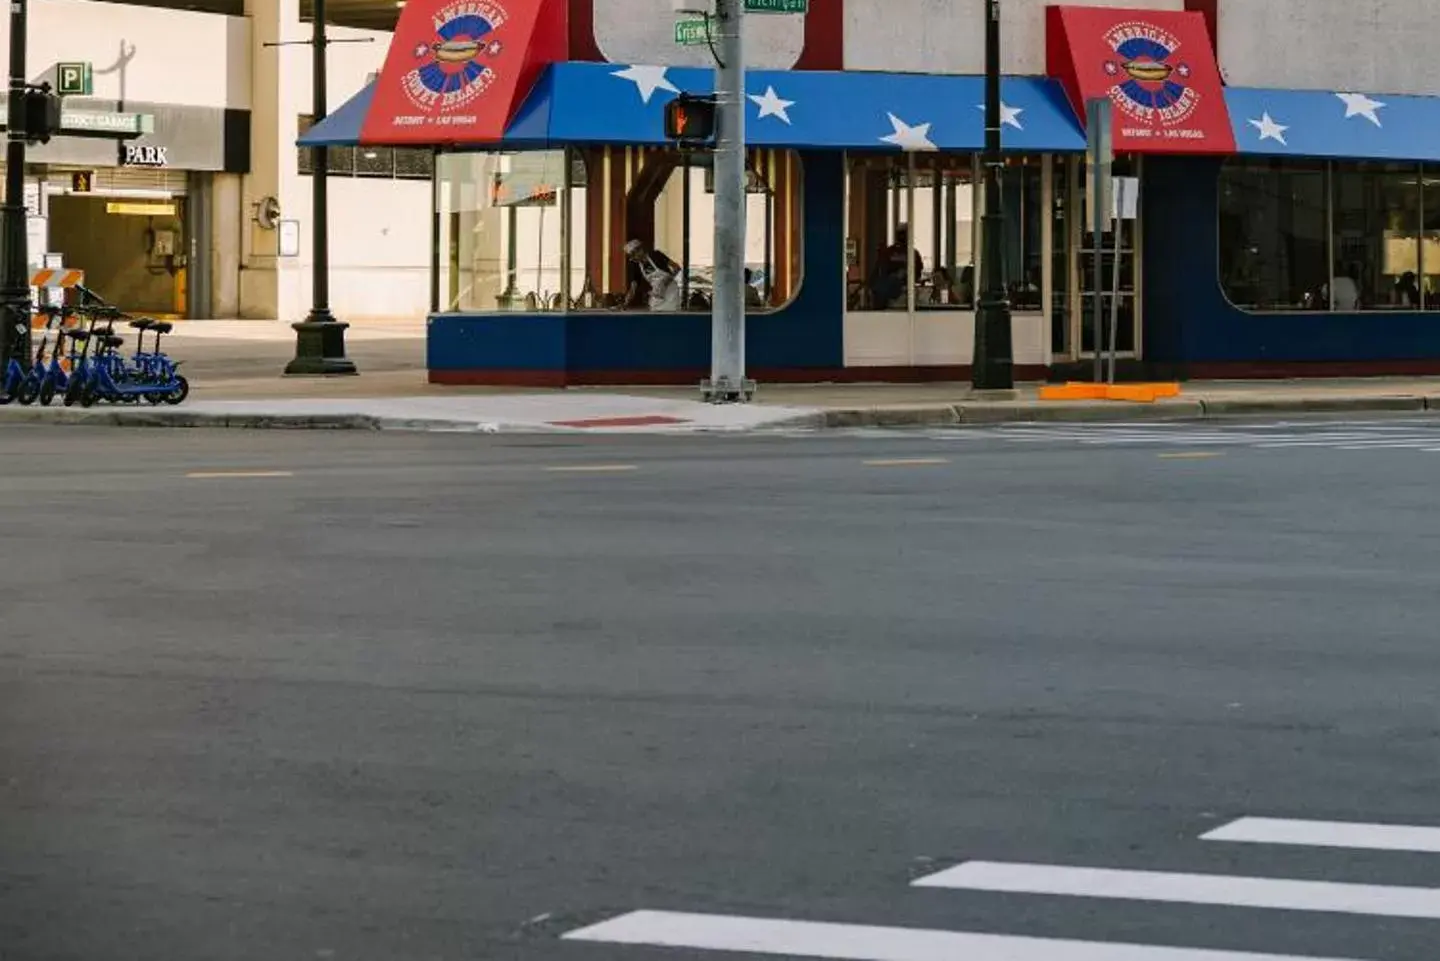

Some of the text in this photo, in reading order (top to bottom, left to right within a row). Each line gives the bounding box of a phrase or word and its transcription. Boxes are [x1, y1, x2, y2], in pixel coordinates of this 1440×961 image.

[433, 2, 505, 32] AMERICAN
[1107, 25, 1179, 54] AMERICAN
[65, 69, 78, 89] P
[405, 67, 494, 107] CONEY ISLAND
[1110, 84, 1195, 122] CONEY ISLAND
[126, 145, 169, 165] PARK
